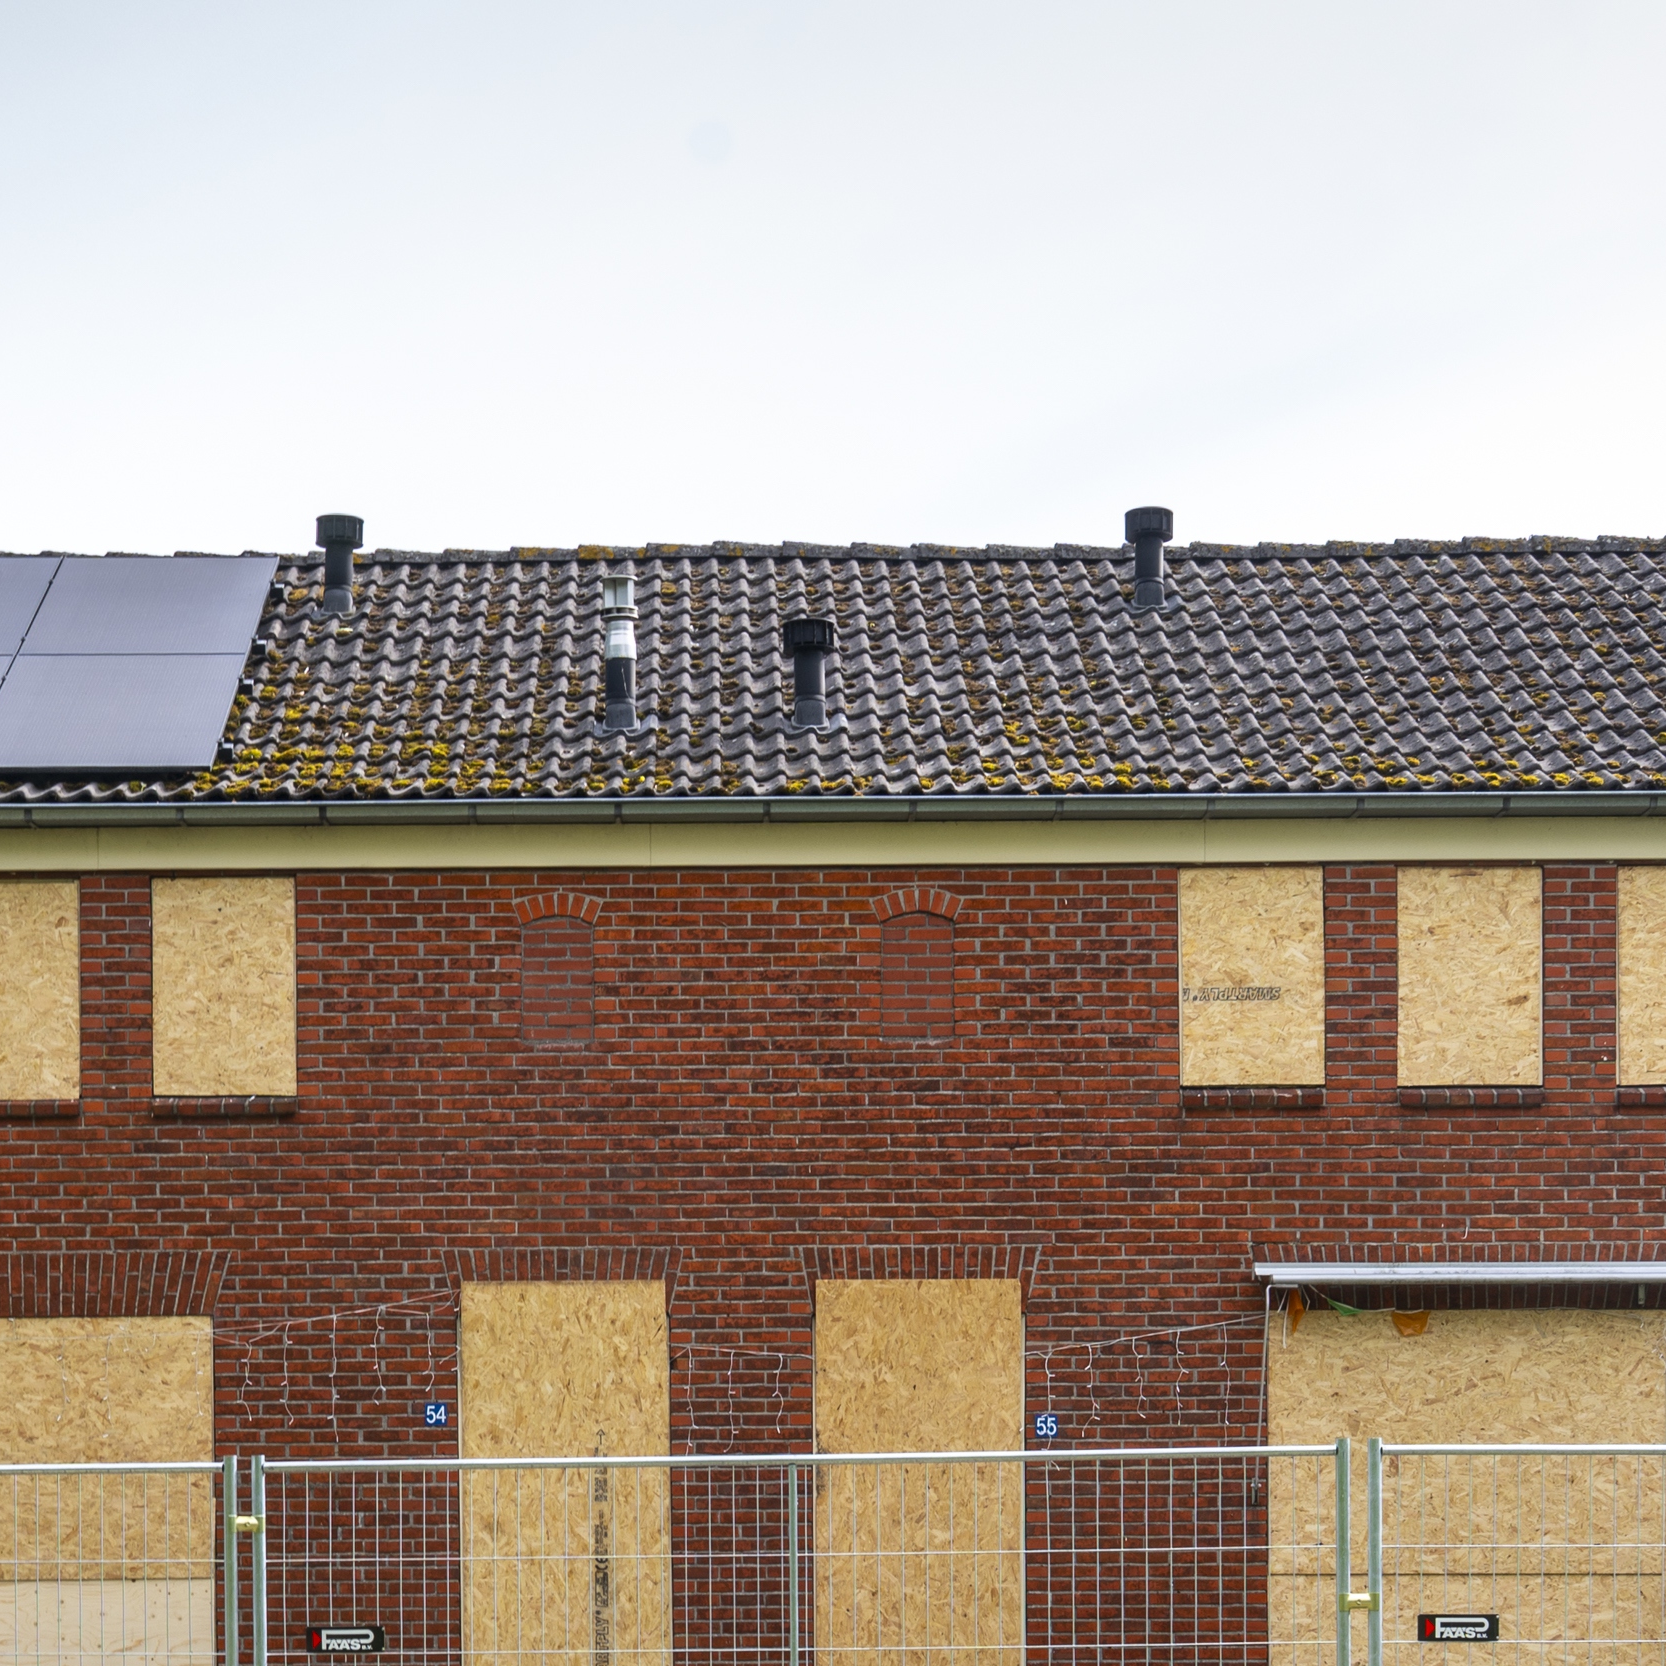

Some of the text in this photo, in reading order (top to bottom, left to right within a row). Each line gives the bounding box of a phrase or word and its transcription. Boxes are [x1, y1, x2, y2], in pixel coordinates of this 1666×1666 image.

[1199, 986, 1281, 1002] SMARTPLY
[426, 1404, 447, 1424] 54
[1036, 1417, 1057, 1436] 55
